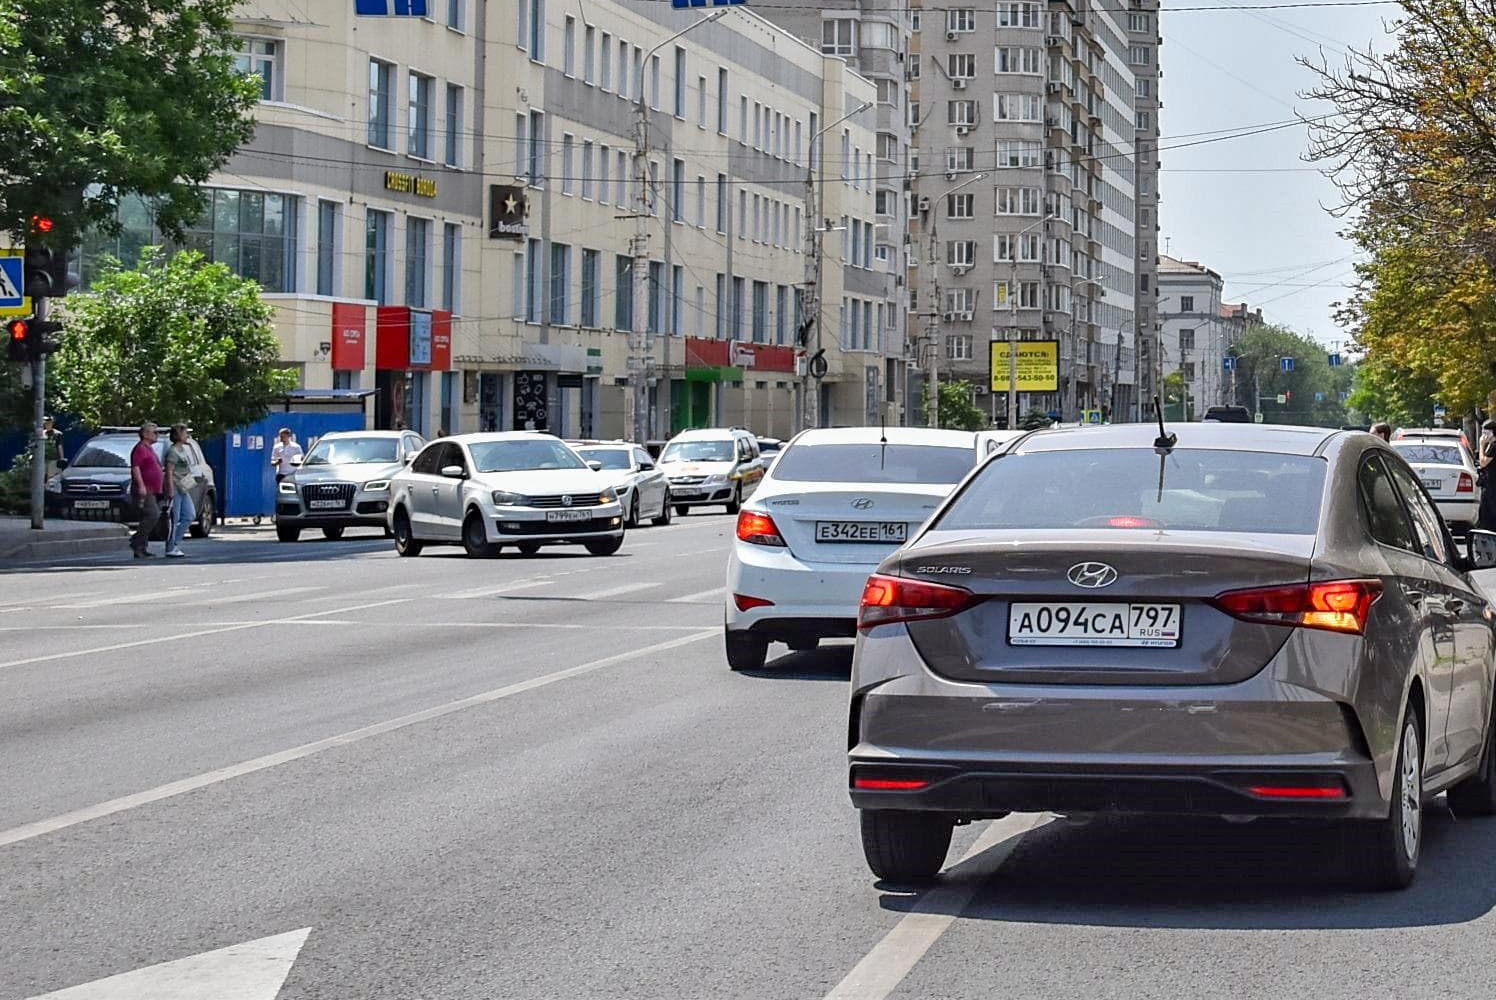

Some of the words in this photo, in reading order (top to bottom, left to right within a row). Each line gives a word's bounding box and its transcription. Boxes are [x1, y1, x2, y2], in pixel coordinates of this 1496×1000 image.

[881, 524, 904, 536] 161
[916, 565, 972, 575] SOLARIS
[1131, 606, 1174, 629] 797
[1139, 628, 1161, 637] RUS
